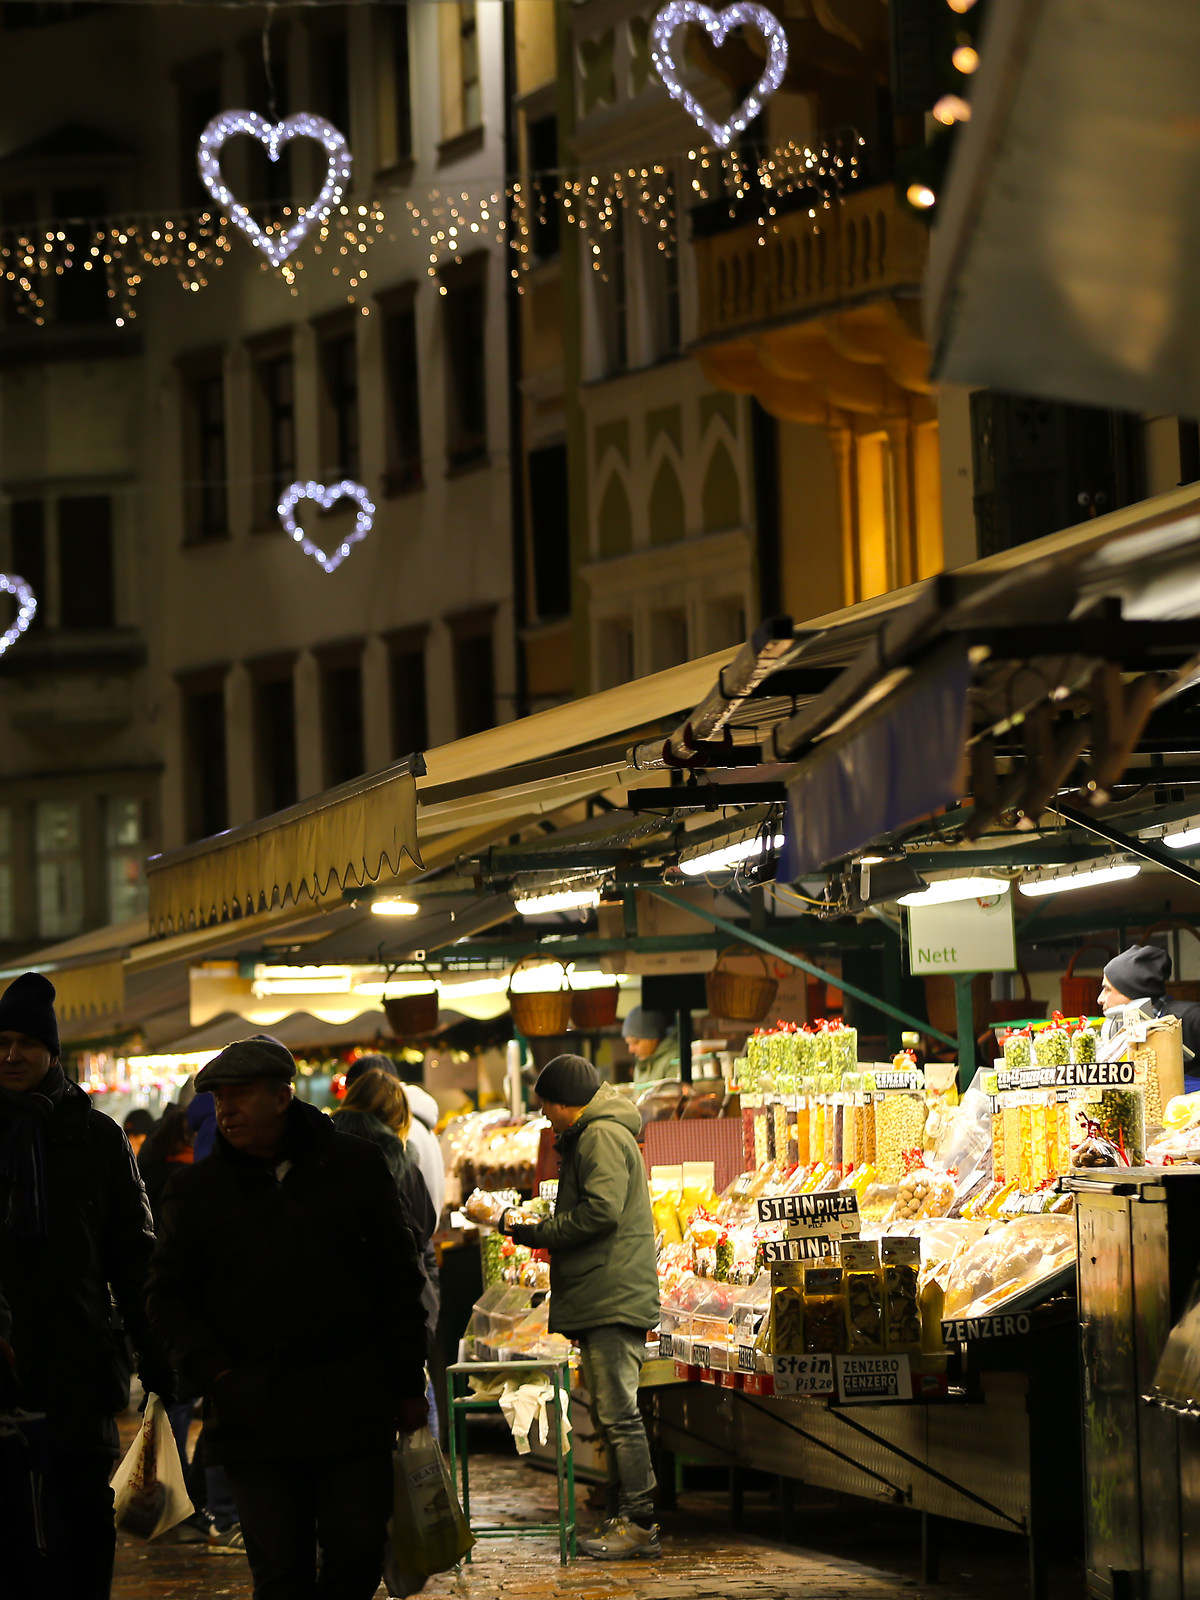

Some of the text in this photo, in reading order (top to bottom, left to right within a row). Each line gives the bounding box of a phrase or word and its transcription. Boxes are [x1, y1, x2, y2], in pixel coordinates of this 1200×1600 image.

[918, 947, 957, 963] Nett
[875, 1072, 916, 1085] ZENZERO
[1056, 1063, 1133, 1086] ZENZERO
[761, 1196, 853, 1221] STEINPILZE
[943, 1314, 1031, 1342] ZENZERO
[776, 1356, 831, 1375] Stein
[843, 1360, 899, 1374] ZENZERO
[844, 1374, 897, 1389] ZENZERO
